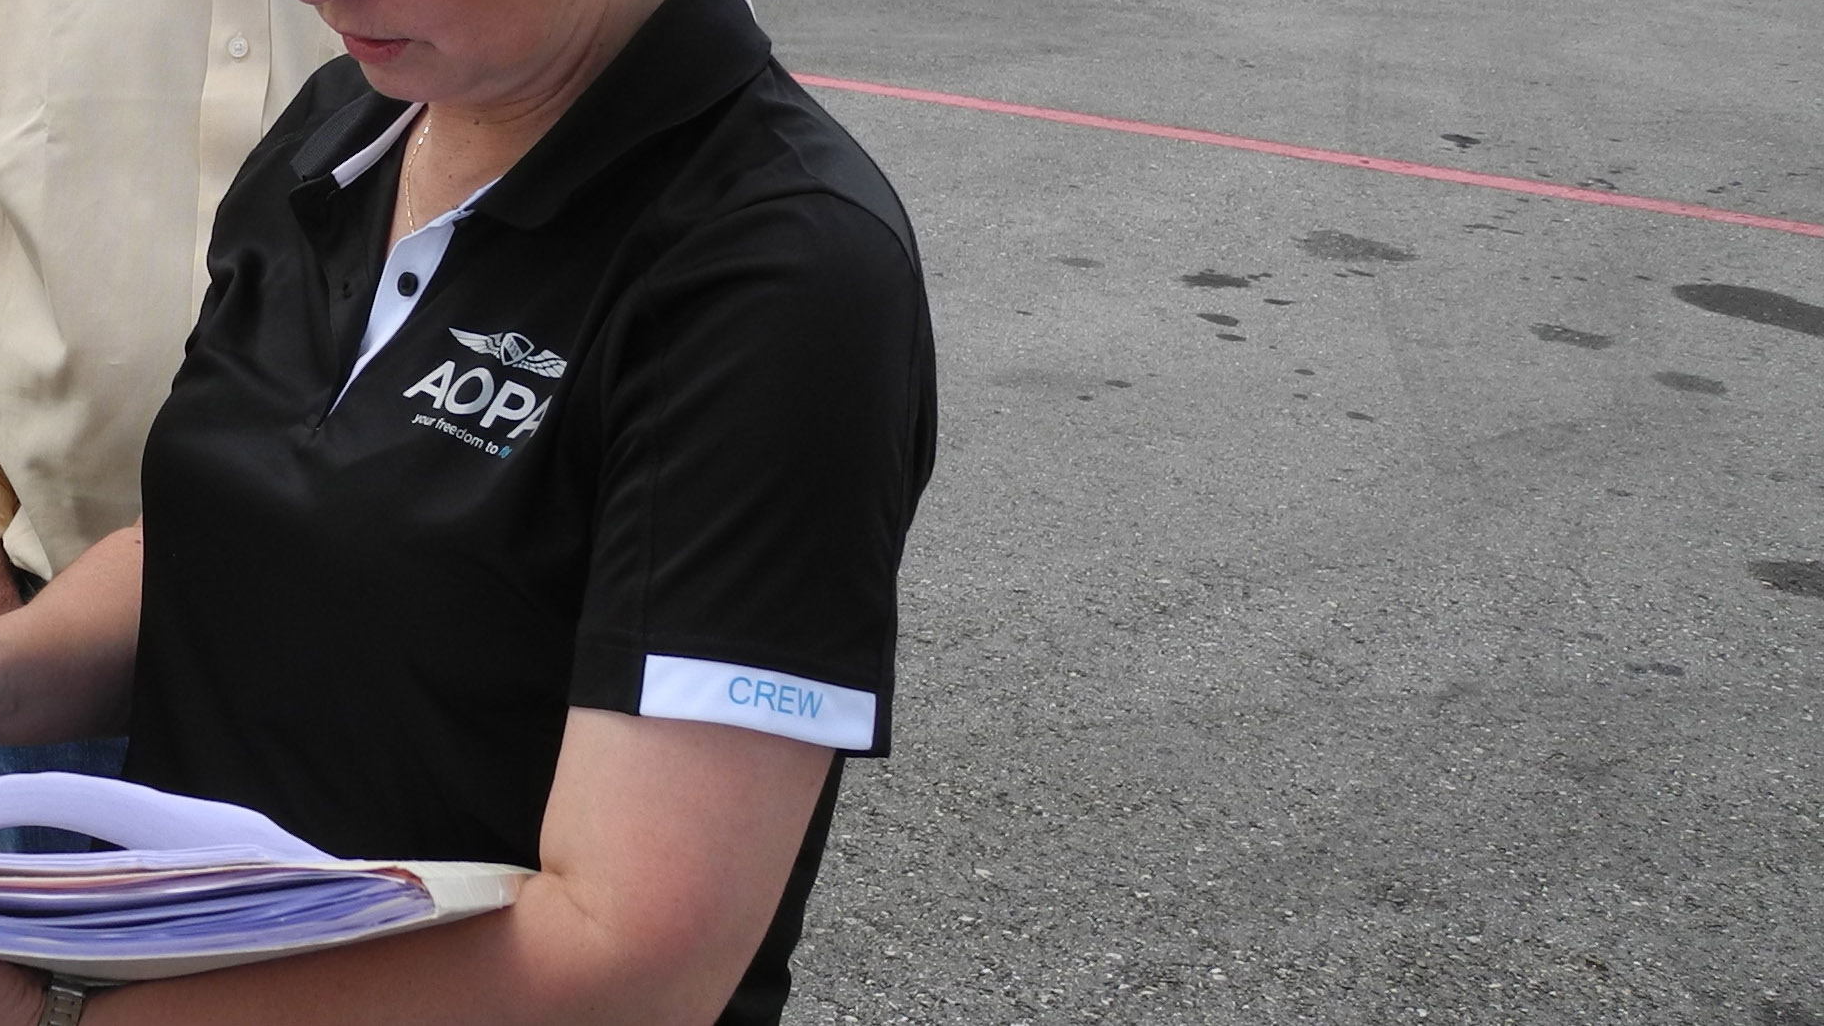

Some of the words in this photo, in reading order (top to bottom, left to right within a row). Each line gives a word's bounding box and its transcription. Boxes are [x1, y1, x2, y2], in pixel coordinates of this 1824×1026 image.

[402, 359, 553, 440] AOPA
[411, 413, 437, 427] your
[435, 417, 485, 450] freedom
[485, 441, 499, 456] to
[728, 676, 824, 719] CREW
